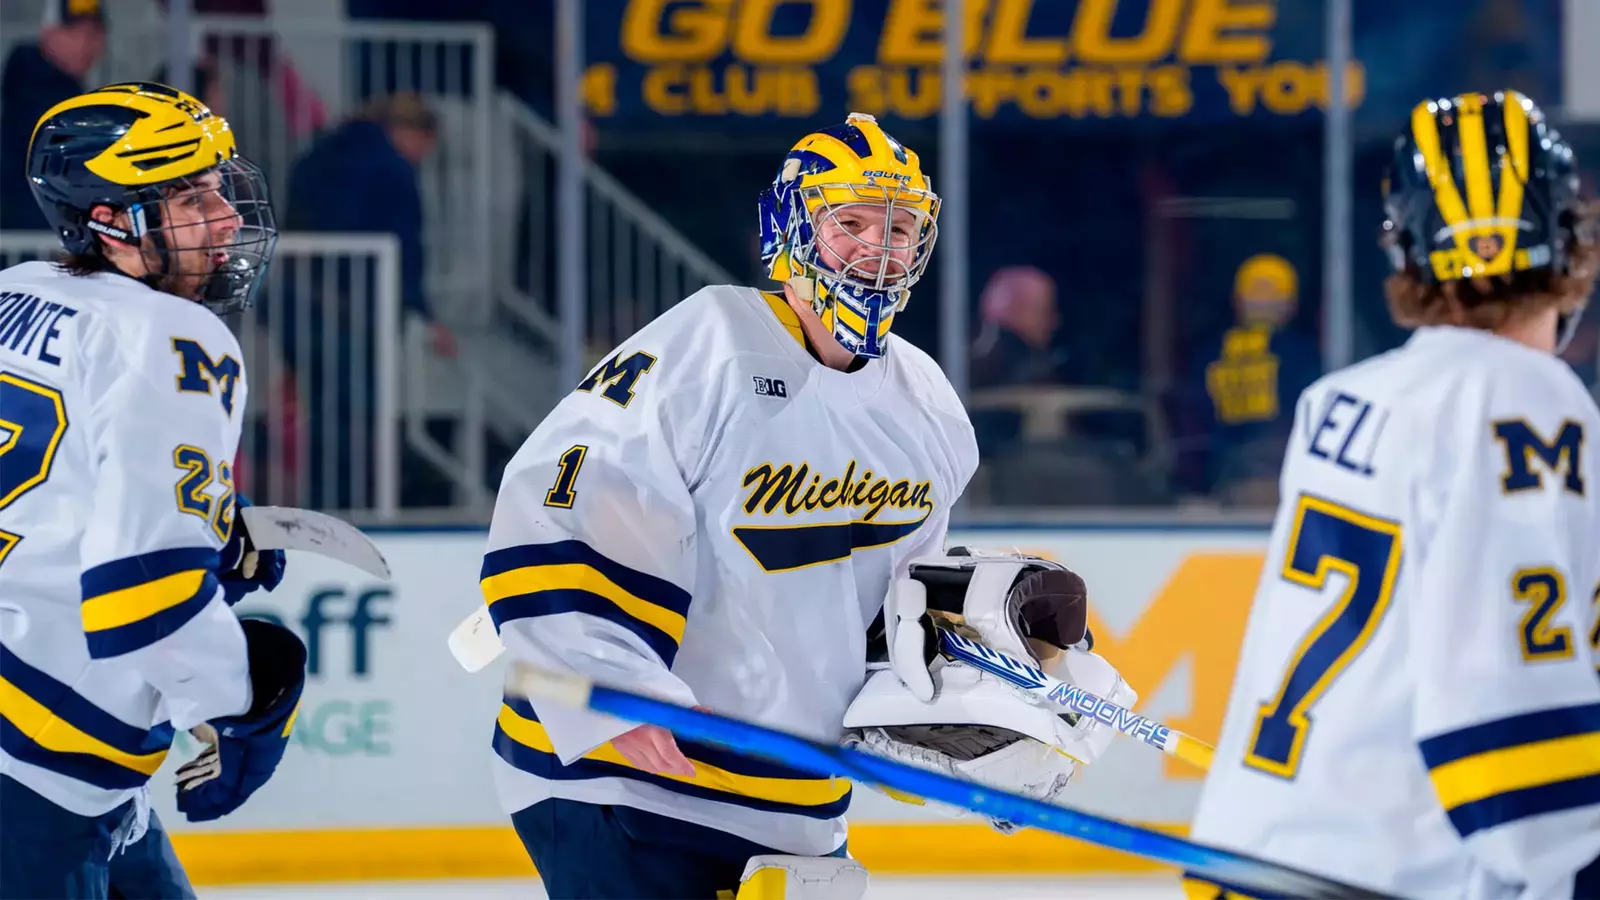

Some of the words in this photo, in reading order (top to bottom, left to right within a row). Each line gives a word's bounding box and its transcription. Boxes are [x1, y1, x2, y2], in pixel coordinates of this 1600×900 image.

[620, 0, 852, 64] GO
[878, 0, 1276, 64] BLUE
[642, 62, 822, 117] CLUB
[860, 168, 912, 182] BAUER
[855, 293, 883, 358] 1
[171, 337, 241, 422] M
[576, 350, 658, 408] M
[544, 444, 588, 508] 1
[1492, 415, 1586, 496] M
[742, 460, 935, 523] Michigan
[1242, 492, 1404, 782] 7
